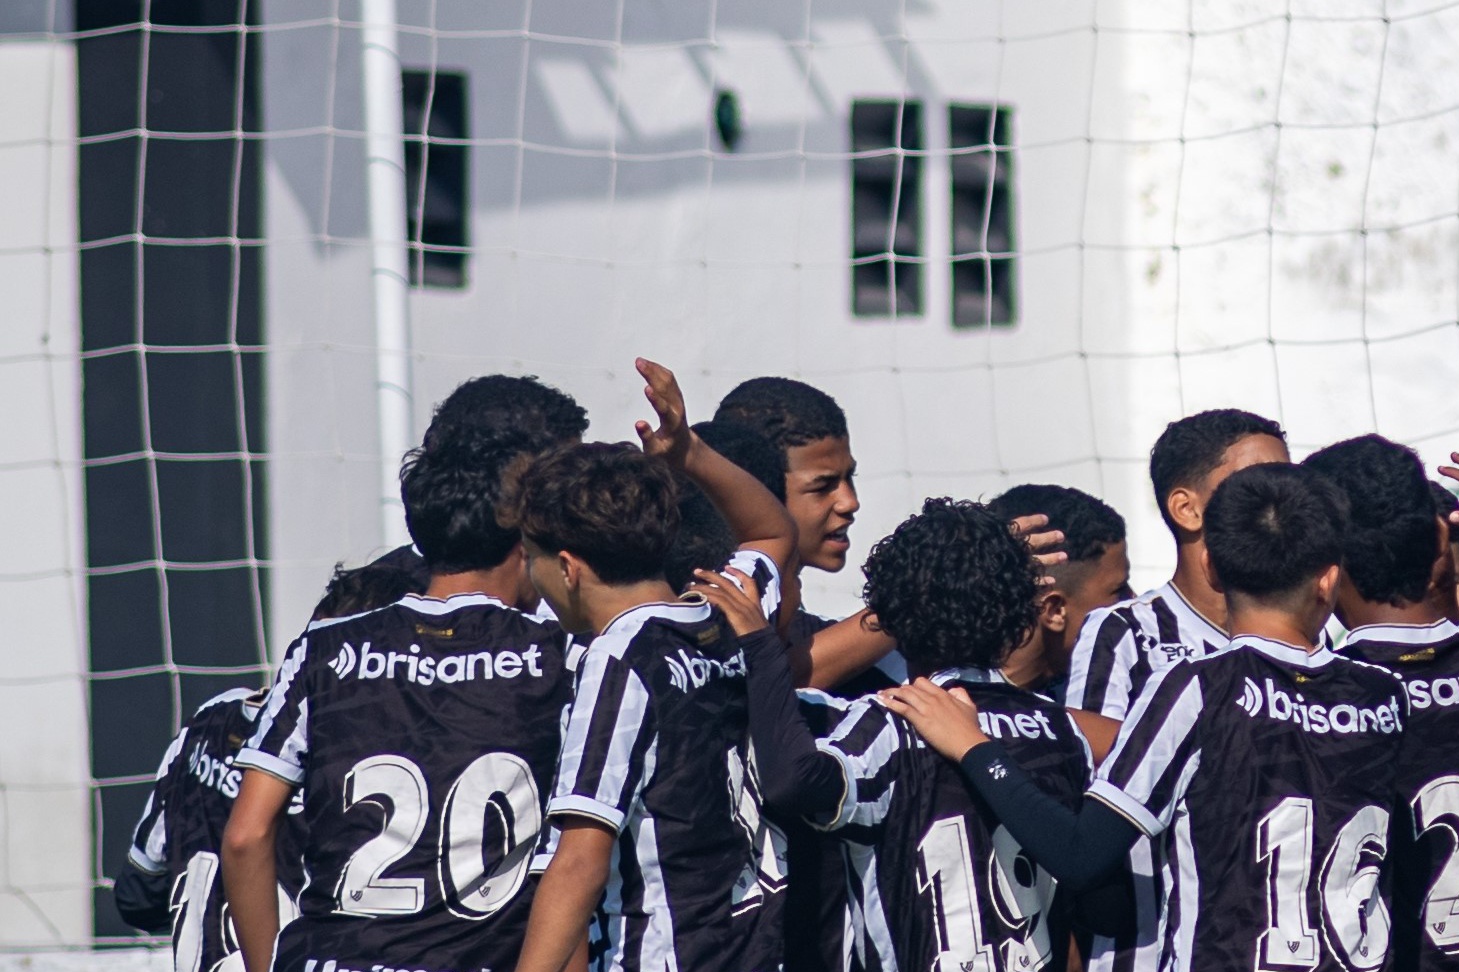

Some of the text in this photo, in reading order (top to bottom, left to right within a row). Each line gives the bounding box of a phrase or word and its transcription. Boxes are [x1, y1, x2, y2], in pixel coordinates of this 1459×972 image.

[358, 641, 543, 686] brisanet
[1264, 677, 1403, 734] brisanet
[331, 752, 542, 921] 20
